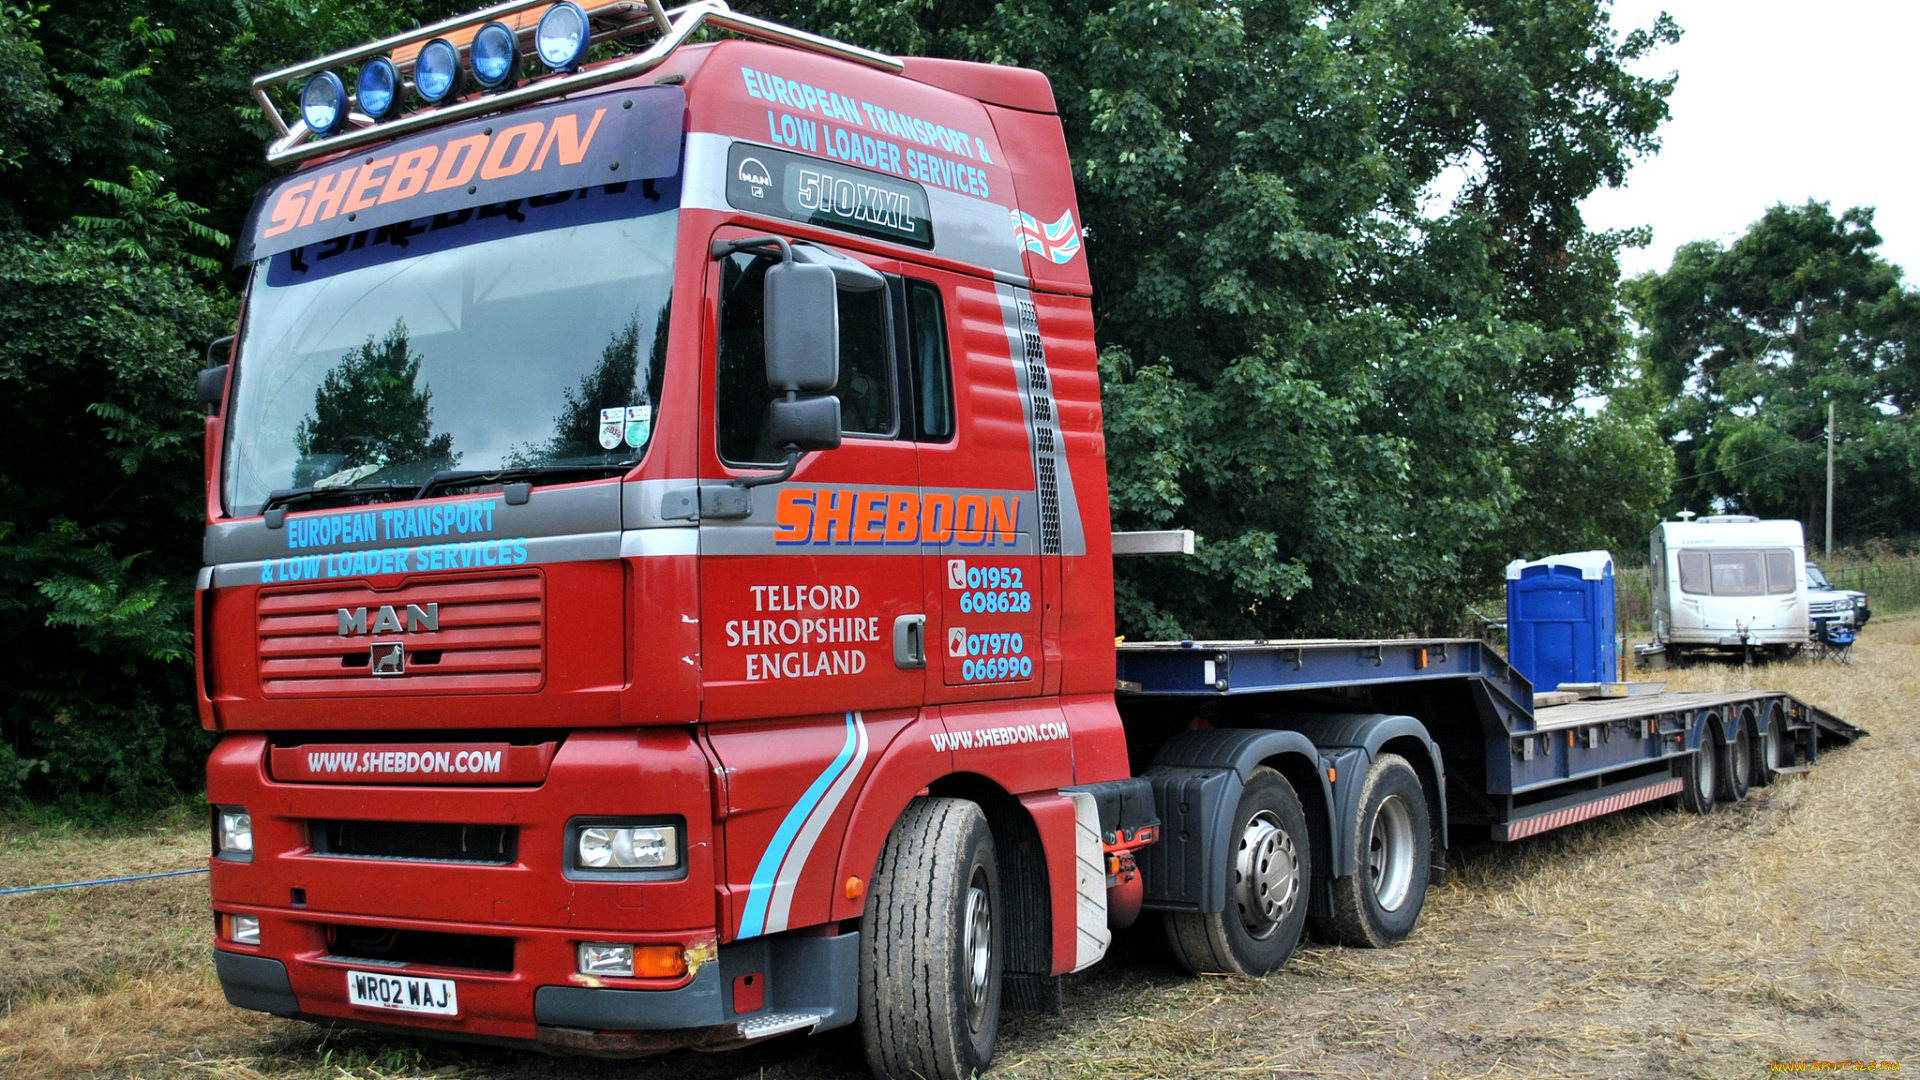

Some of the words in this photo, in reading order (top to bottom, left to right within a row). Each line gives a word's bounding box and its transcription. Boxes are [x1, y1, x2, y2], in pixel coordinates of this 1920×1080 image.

[741, 67, 864, 127] EUROPEAN
[863, 102, 974, 159] TRANSPORT
[975, 137, 993, 165] &
[767, 110, 817, 153] LOW
[824, 126, 903, 175] LOADER
[905, 148, 990, 198] SERVICES
[263, 108, 608, 239] SHEBDON
[742, 172, 769, 187] MAN
[797, 169, 915, 232] 510XXL
[288, 513, 377, 548] EUROPEAN
[382, 501, 496, 539] TRANSPORT
[773, 488, 1021, 547] SHEBDON
[261, 558, 274, 583] &
[279, 553, 321, 582] LOW
[327, 547, 409, 577] LOADER
[416, 537, 528, 570] SERVICES
[966, 566, 1023, 589] 01952
[750, 585, 860, 612] TELFORD
[960, 591, 1031, 613] 608628
[337, 602, 439, 636] MAN
[726, 616, 880, 647] SHROPSHIRE
[967, 632, 1023, 656] 07970
[745, 650, 866, 681] ENGLAND
[962, 656, 1032, 681] 066990
[929, 721, 1069, 752] WWW.SHEBDON.COM
[308, 749, 502, 774] WWW.SHEBDON.COM
[355, 974, 404, 1004] WR02
[408, 980, 448, 1008] WAJ
